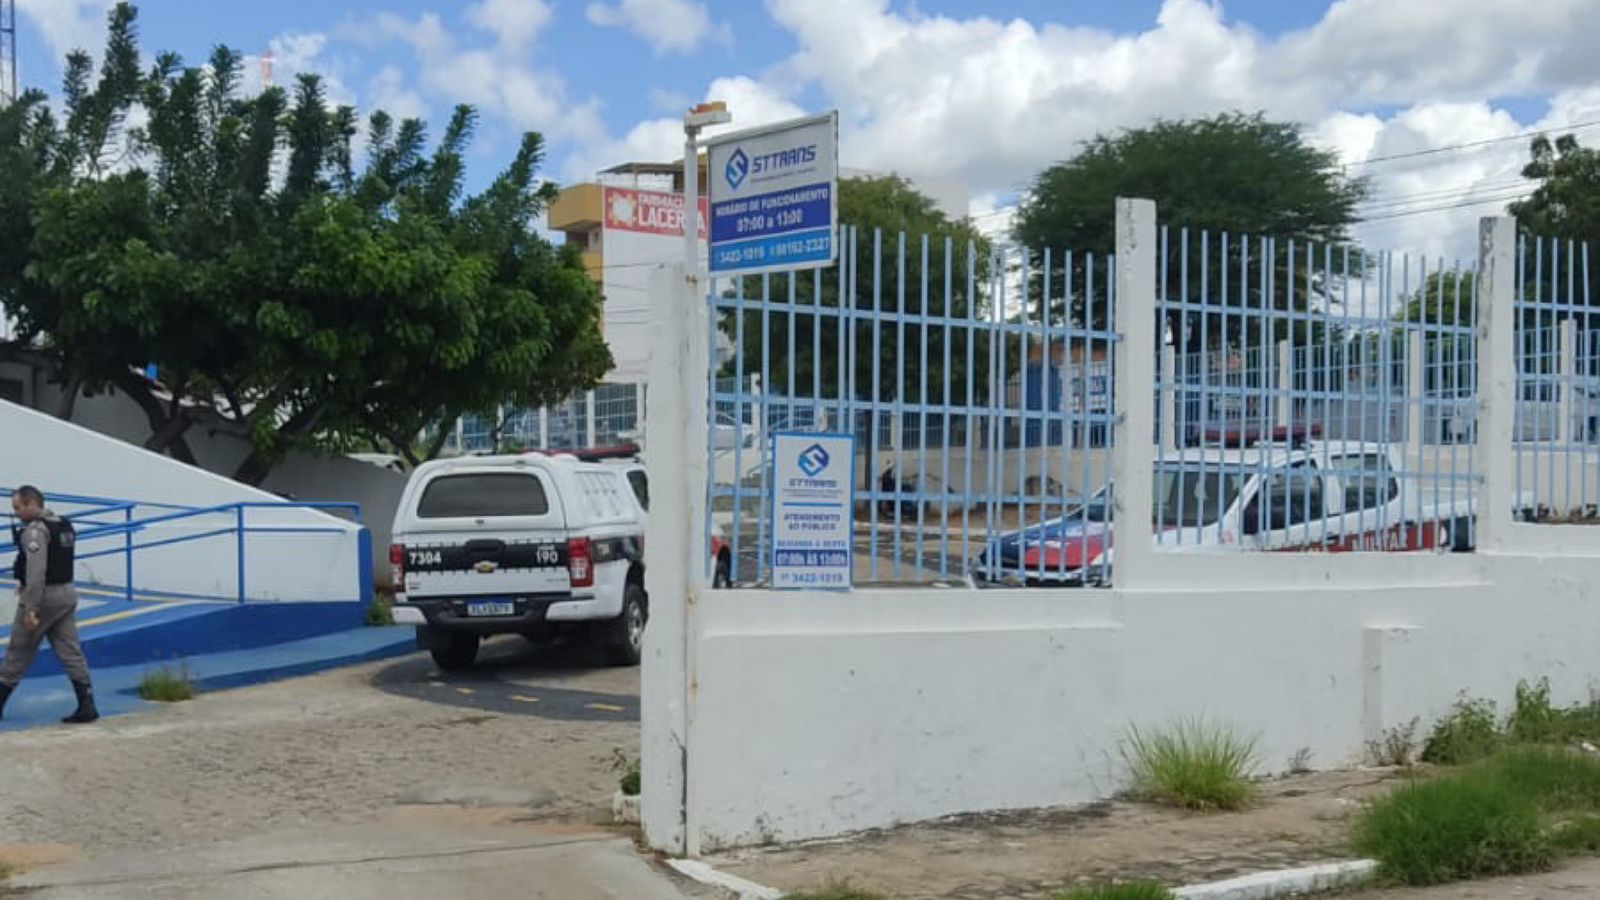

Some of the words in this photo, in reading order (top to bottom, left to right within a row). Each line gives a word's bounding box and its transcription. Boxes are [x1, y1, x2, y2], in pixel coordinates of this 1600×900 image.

[749, 199, 761, 212] DE
[638, 204, 706, 233] LACERA
[408, 550, 442, 566] 7304
